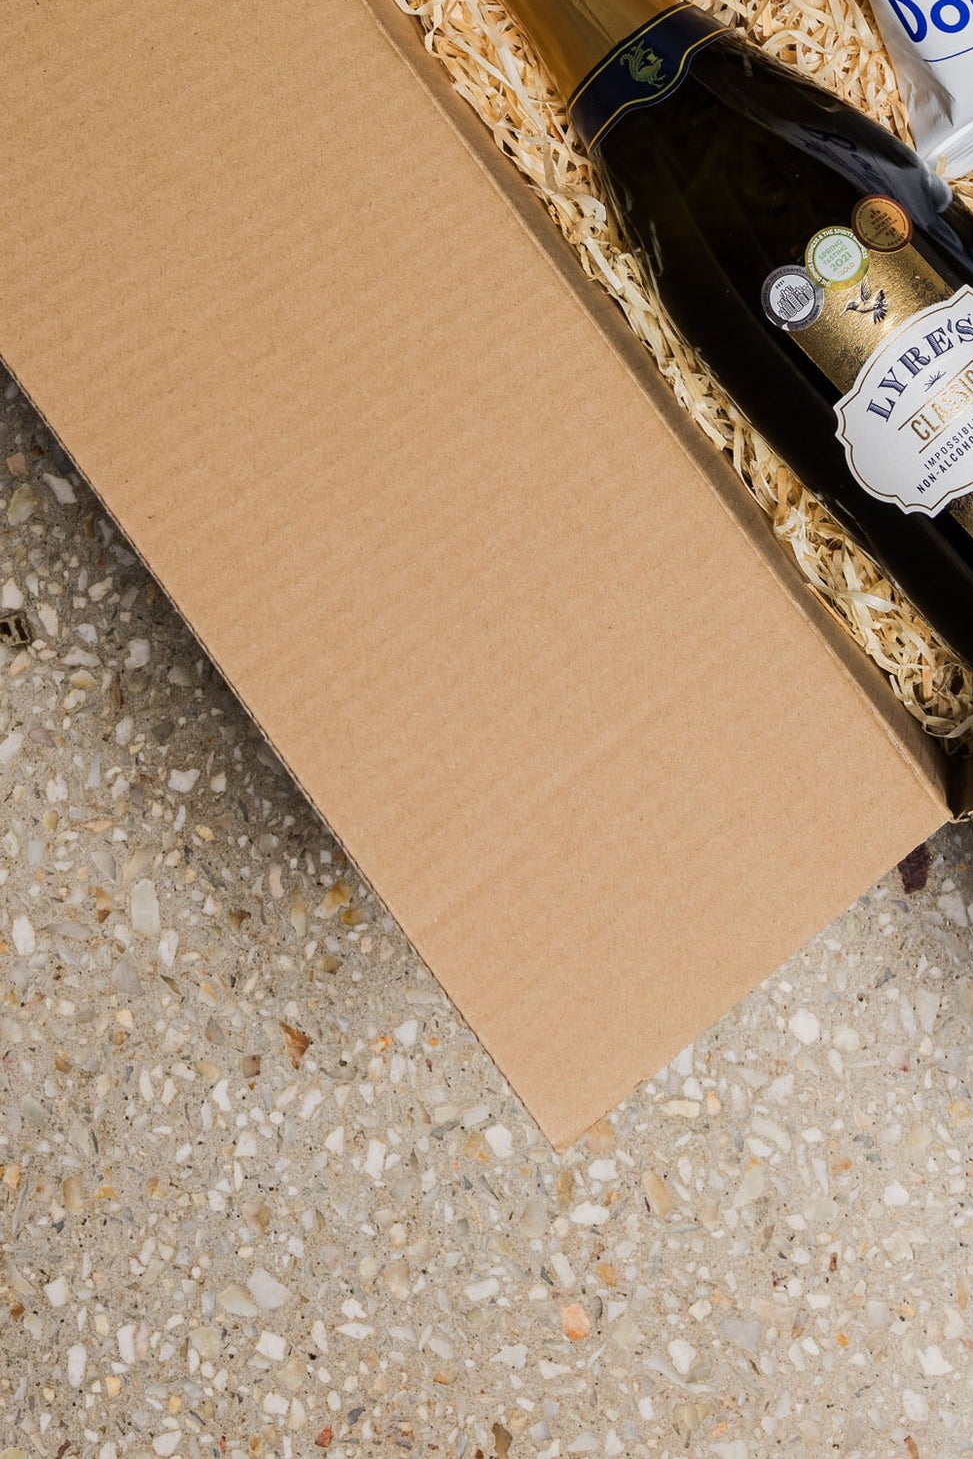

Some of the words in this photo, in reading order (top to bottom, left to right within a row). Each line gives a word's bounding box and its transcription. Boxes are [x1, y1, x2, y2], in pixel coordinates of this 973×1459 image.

[818, 239, 843, 260] SPRING
[823, 244, 847, 265] TASTING
[830, 251, 852, 272] 2021
